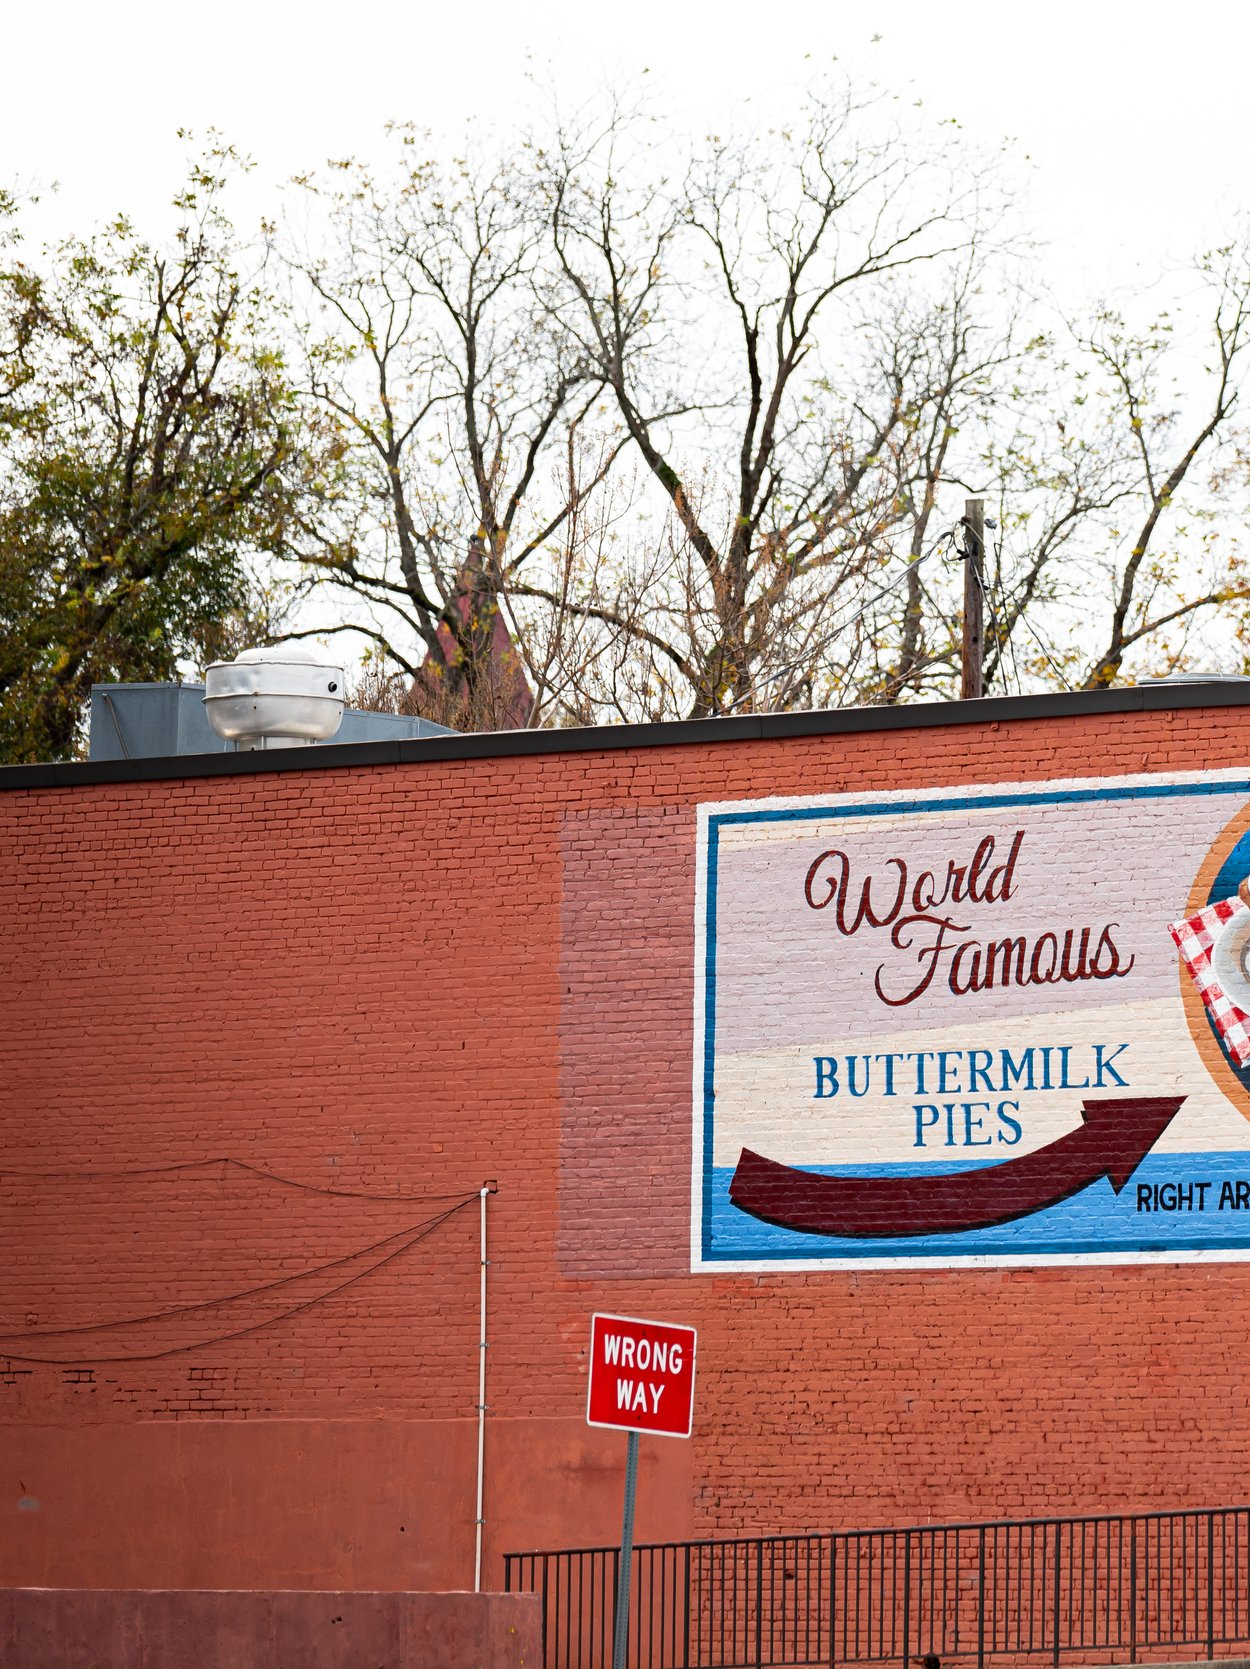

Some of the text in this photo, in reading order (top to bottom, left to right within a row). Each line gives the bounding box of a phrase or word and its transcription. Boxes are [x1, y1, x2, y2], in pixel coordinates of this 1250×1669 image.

[804, 829, 1025, 936] World
[874, 914, 1134, 1007] Famous
[812, 1043, 1130, 1099] BUTTERMILK
[912, 1100, 1022, 1148] PIES
[1136, 1182, 1211, 1212] RIGHT
[604, 1333, 683, 1375] WRONG
[616, 1378, 666, 1415] WAY
